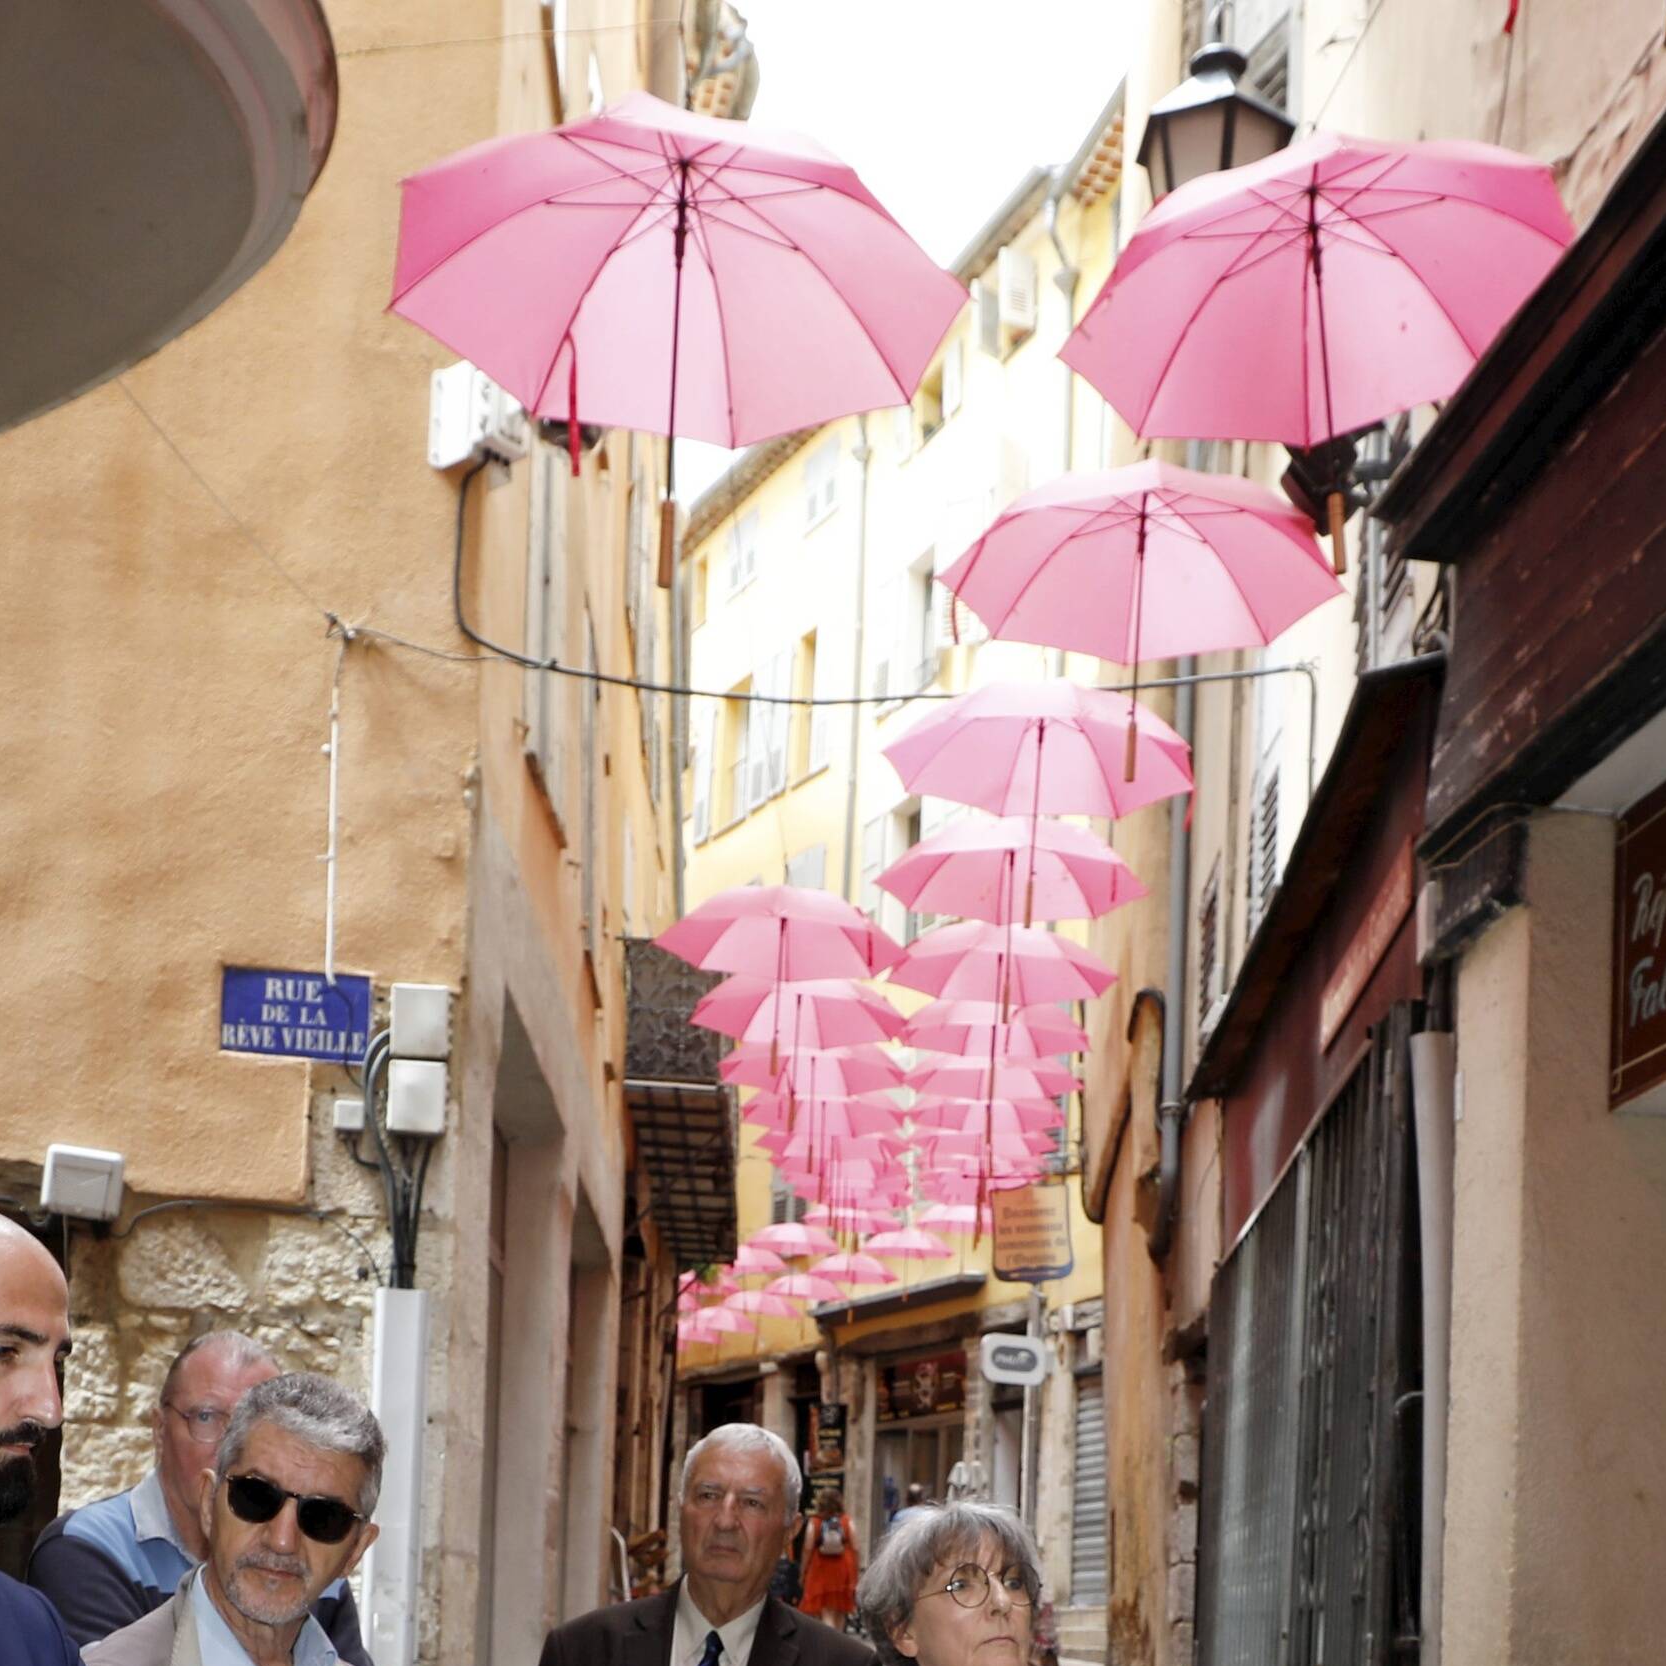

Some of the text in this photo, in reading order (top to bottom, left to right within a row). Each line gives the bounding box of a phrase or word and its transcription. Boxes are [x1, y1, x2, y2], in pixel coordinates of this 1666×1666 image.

[264, 976, 324, 1003] RUE
[261, 1003, 328, 1026] DE LA
[281, 1026, 366, 1055] VIEILLE
